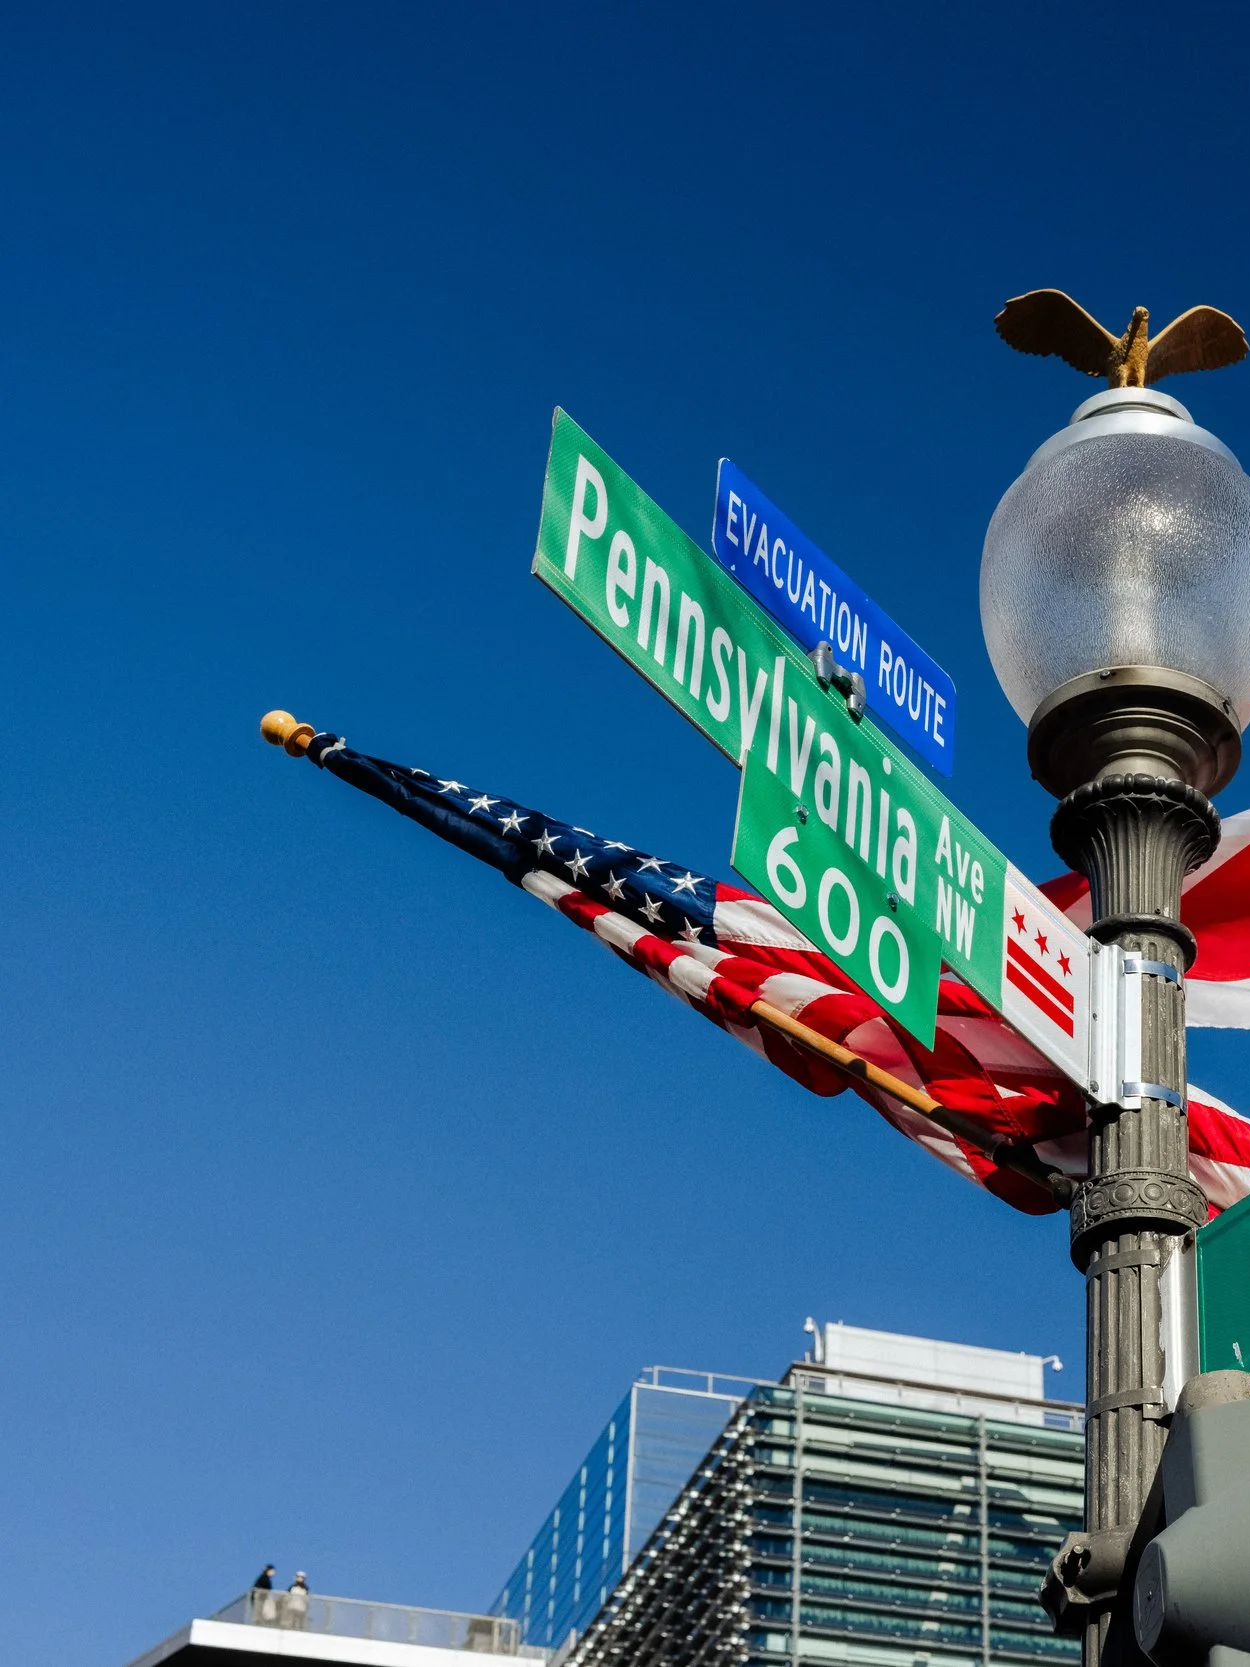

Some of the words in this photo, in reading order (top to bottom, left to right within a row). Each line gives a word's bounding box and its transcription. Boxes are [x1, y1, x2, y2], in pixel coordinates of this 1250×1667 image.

[563, 453, 917, 907] Pennsylvania
[934, 815, 984, 904] Ave
[726, 489, 868, 671] EVACUATION
[878, 639, 947, 748] ROUTE
[765, 826, 910, 1004] 600
[936, 875, 976, 961] NW
